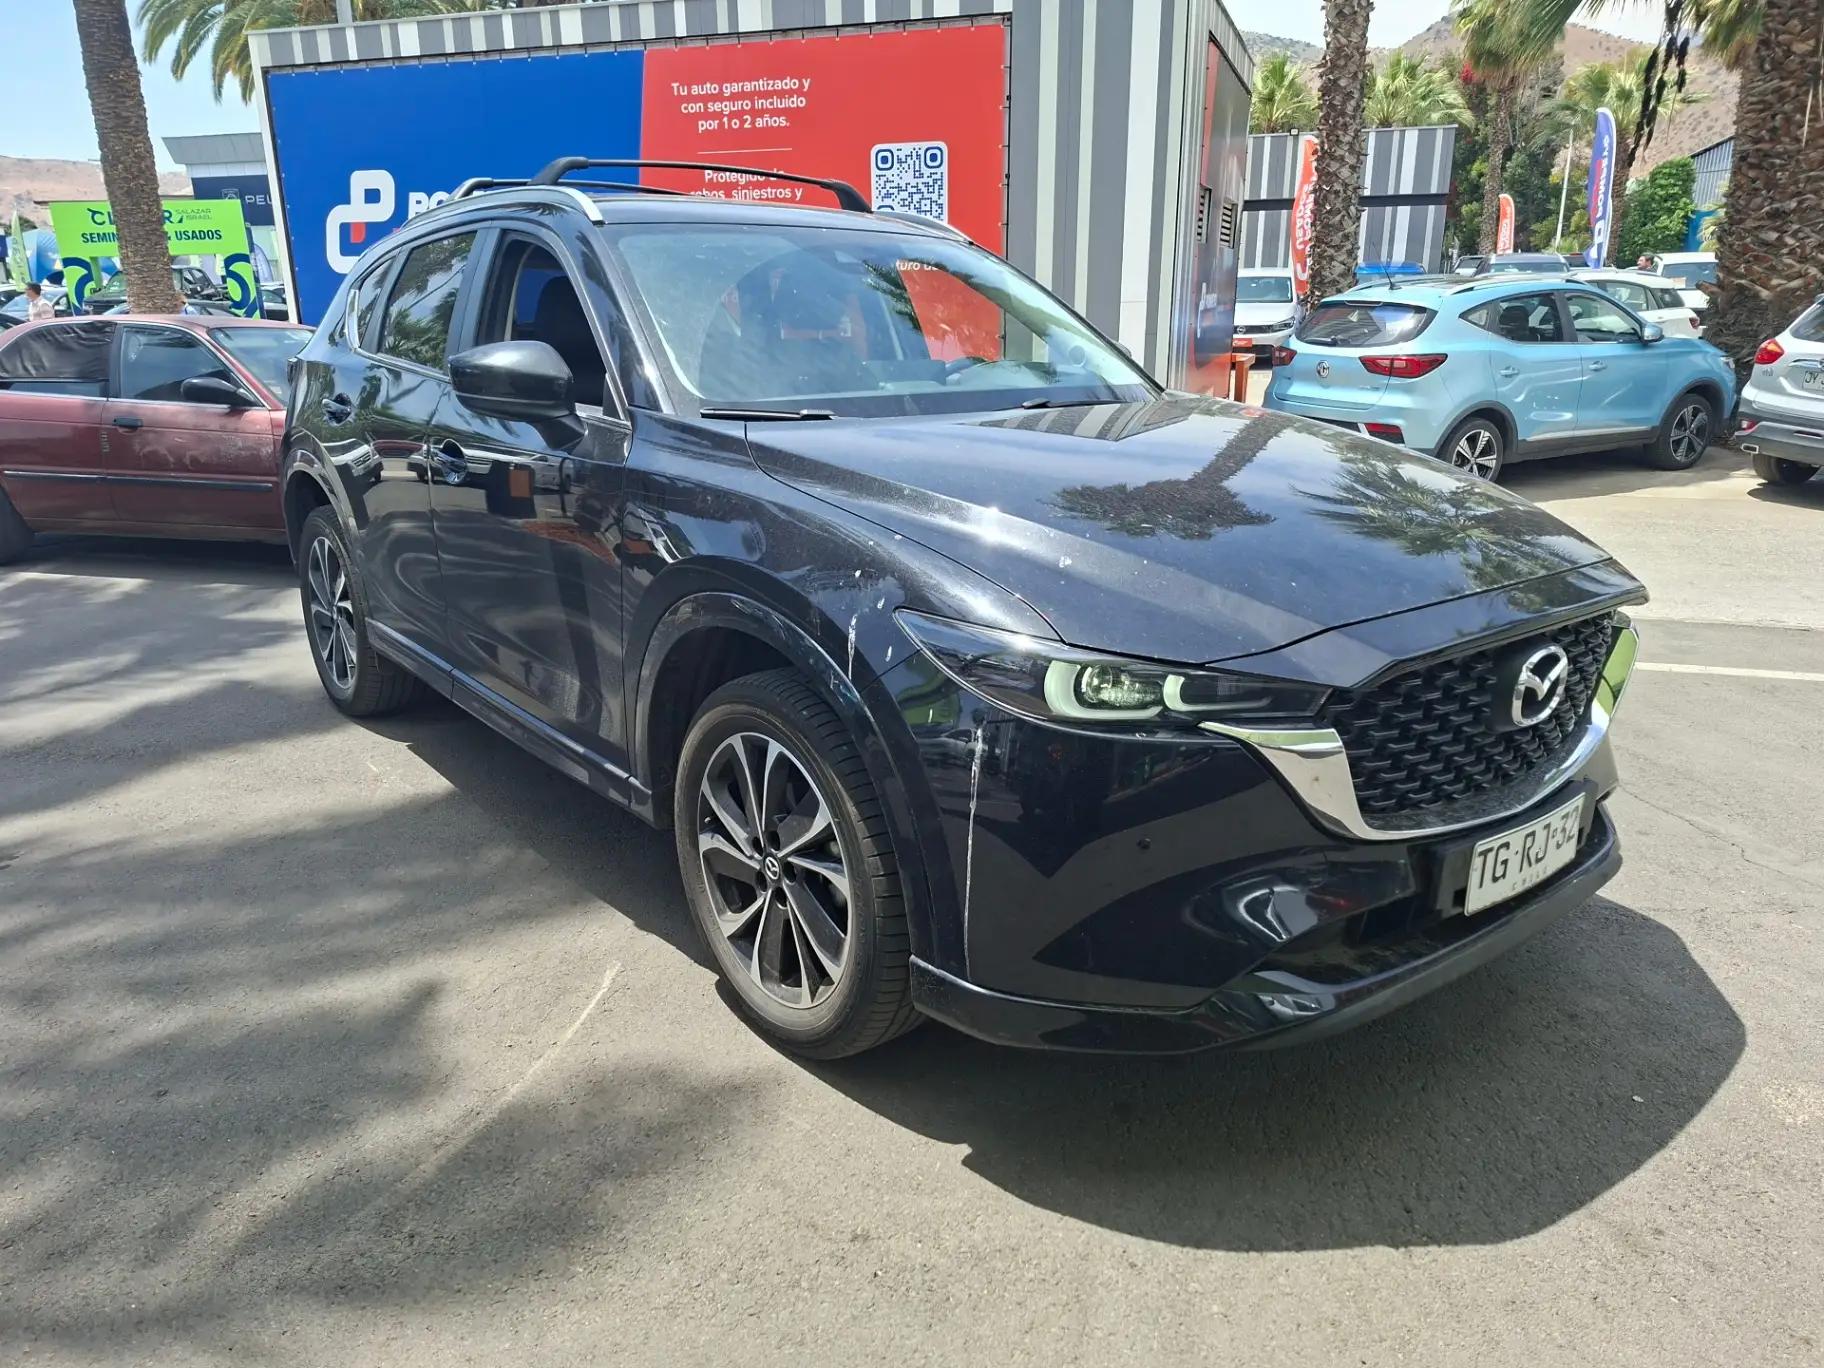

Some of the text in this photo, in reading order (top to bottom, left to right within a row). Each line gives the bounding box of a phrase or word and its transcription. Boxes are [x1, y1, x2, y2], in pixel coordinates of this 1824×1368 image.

[671, 76, 811, 96] Tu auto garantizado y
[681, 94, 806, 114] con seguro incluido
[698, 114, 790, 133] por 1 o 2 años.
[795, 187, 803, 200] y
[174, 229, 222, 241] USADOS
